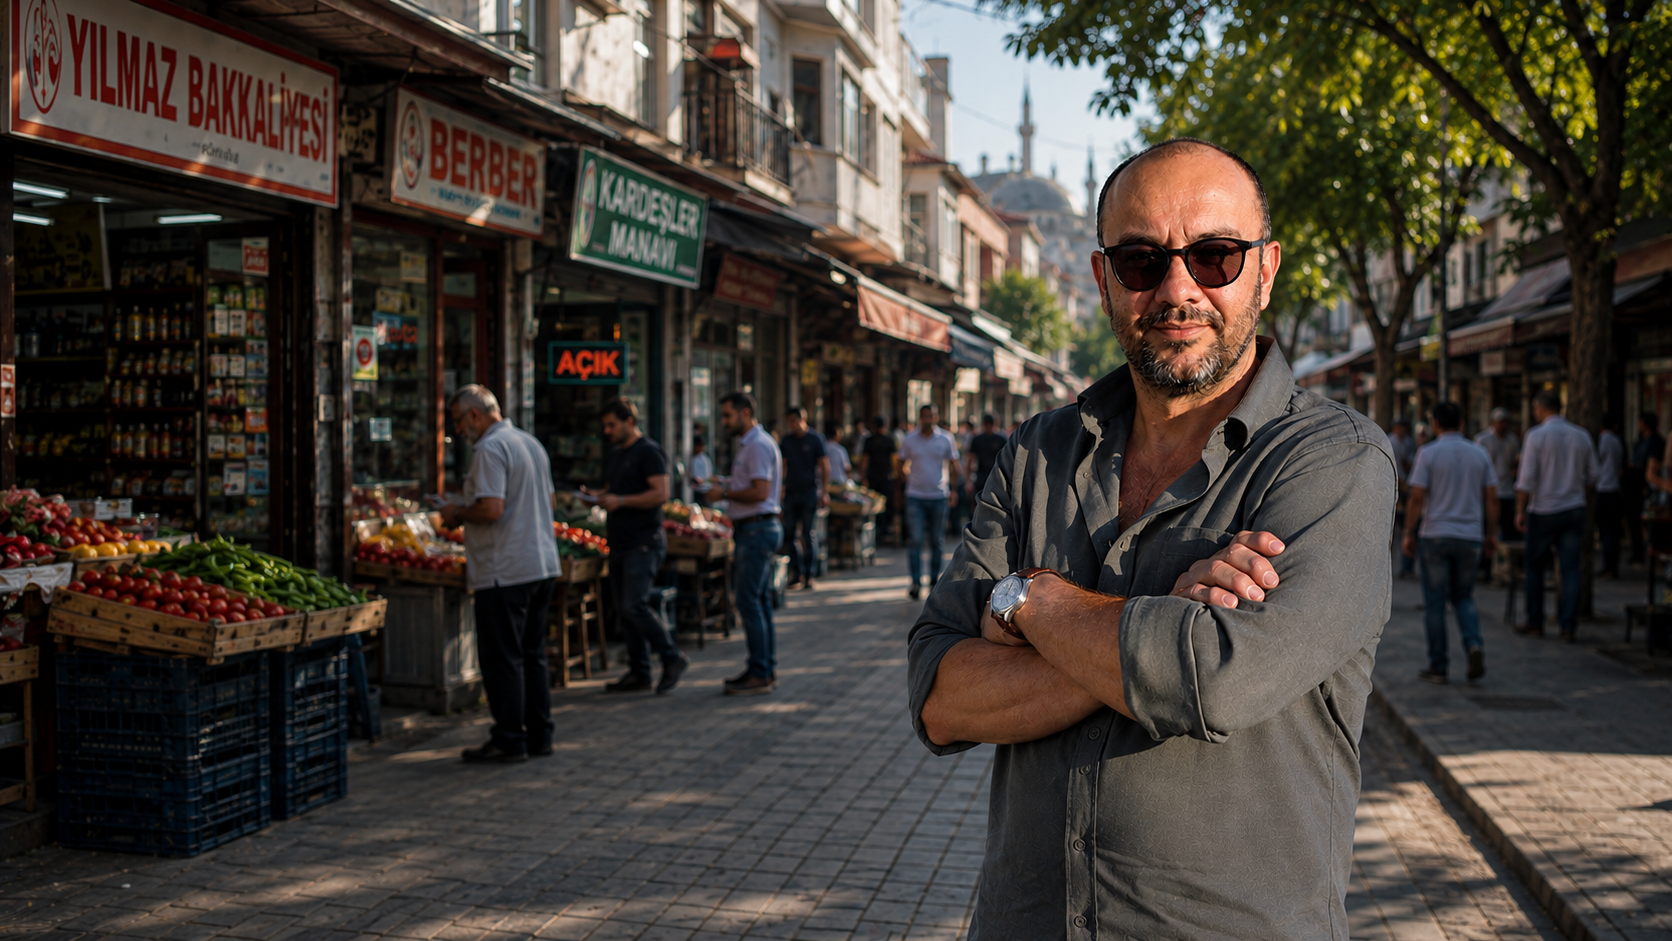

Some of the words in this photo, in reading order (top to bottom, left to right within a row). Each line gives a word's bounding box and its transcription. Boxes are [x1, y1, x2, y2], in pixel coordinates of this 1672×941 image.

[66, 13, 177, 122] YILMAZ
[188, 54, 328, 163] BAKKALİYESİ
[429, 117, 537, 210] BERBER
[598, 169, 699, 239] KARDEŞLER
[608, 221, 677, 271] MANAVI
[556, 350, 619, 381] AÇIK
